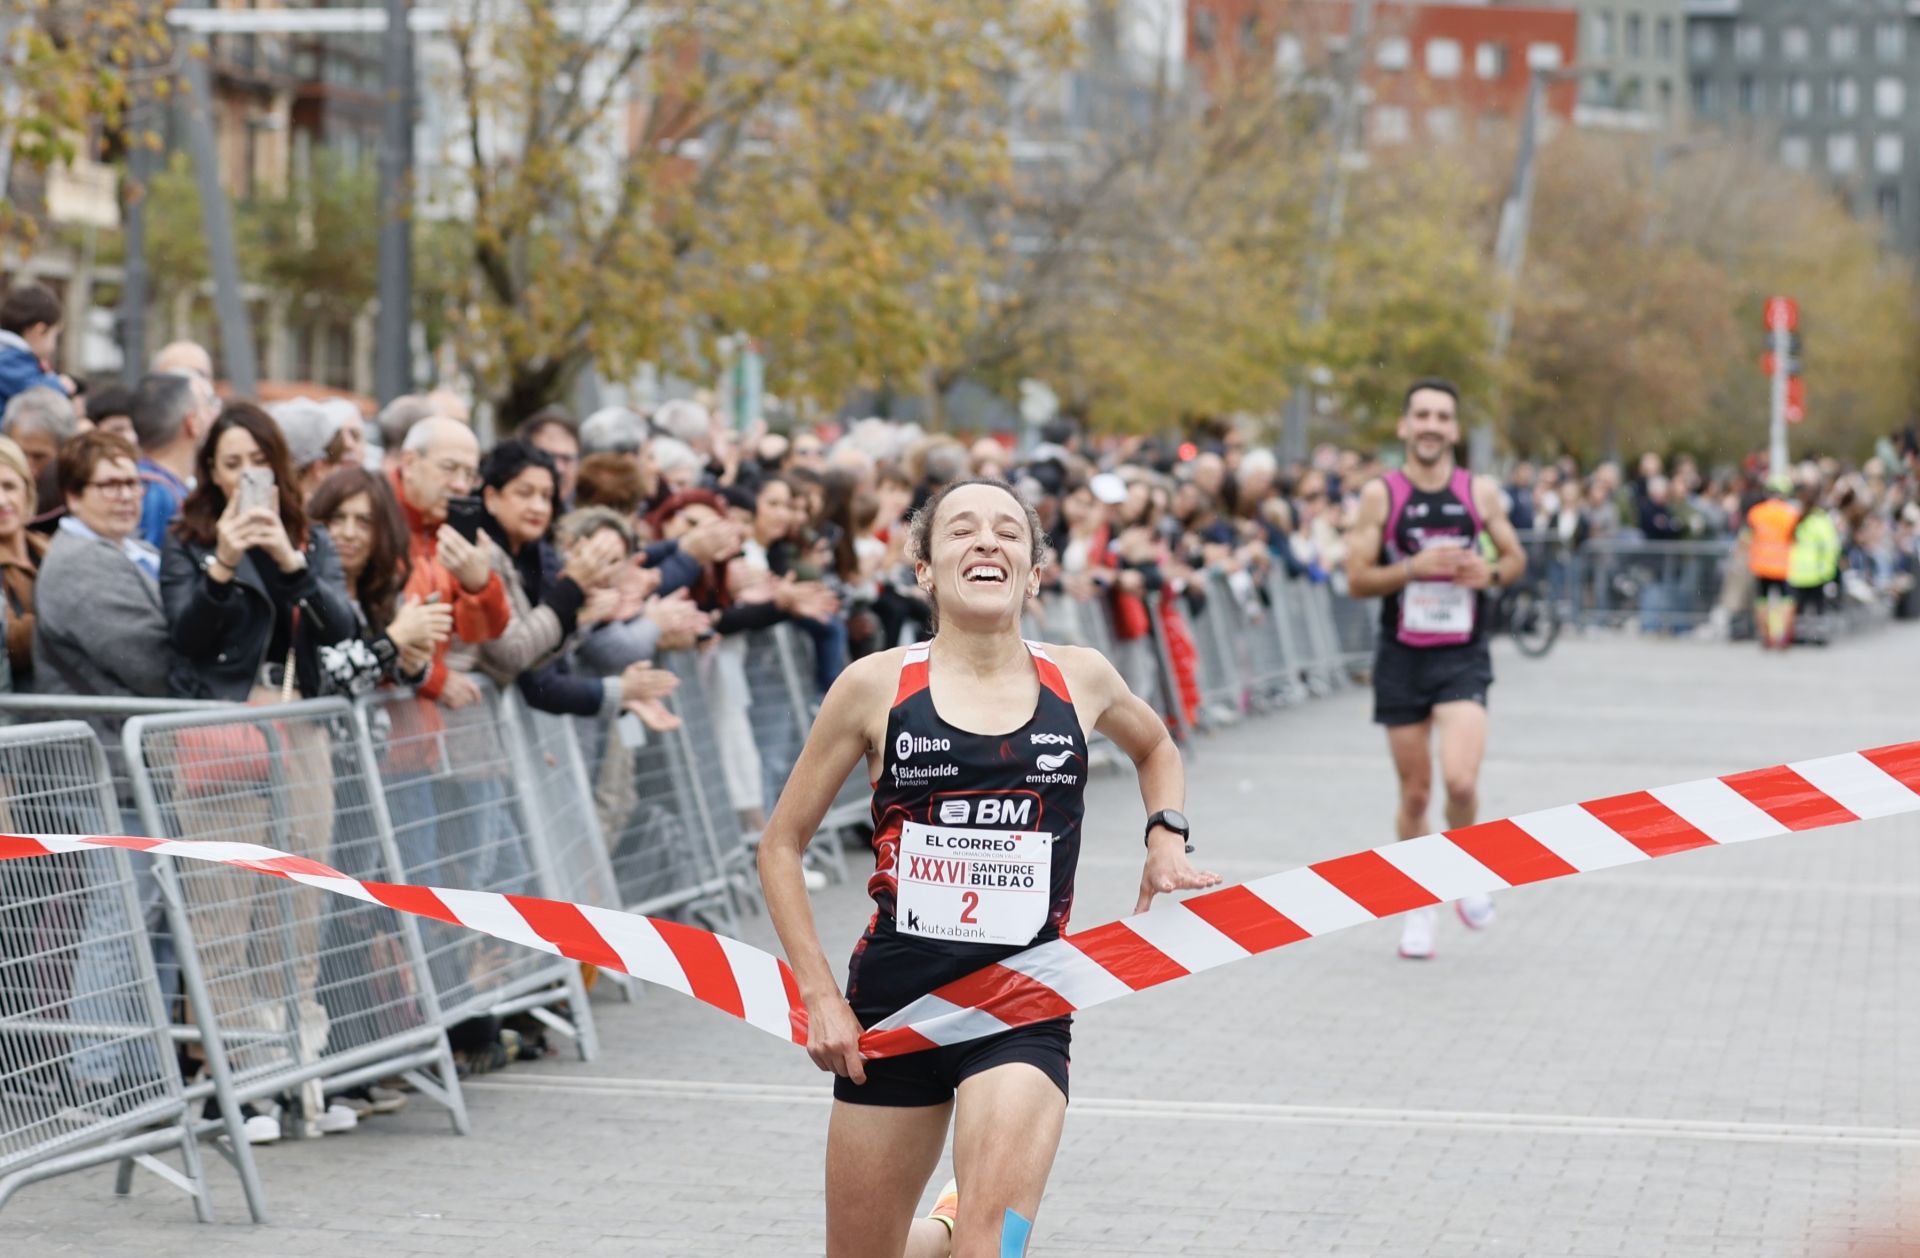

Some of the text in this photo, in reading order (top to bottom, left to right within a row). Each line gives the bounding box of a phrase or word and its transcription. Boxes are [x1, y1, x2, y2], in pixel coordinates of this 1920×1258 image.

[896, 732, 951, 760] Bilbao
[899, 763, 959, 779] Bizkaialde
[1025, 773, 1078, 785] emteSPORT
[975, 799, 1031, 825] BM
[925, 834, 1016, 852] EL CORREO
[952, 850, 991, 859] INFORMACIÓN
[909, 855, 966, 884] XXXVI
[972, 862, 1035, 876] SANTURCE
[971, 873, 1035, 888] BILBAO
[960, 891, 979, 925] 2
[921, 921, 986, 938] kutxabank
